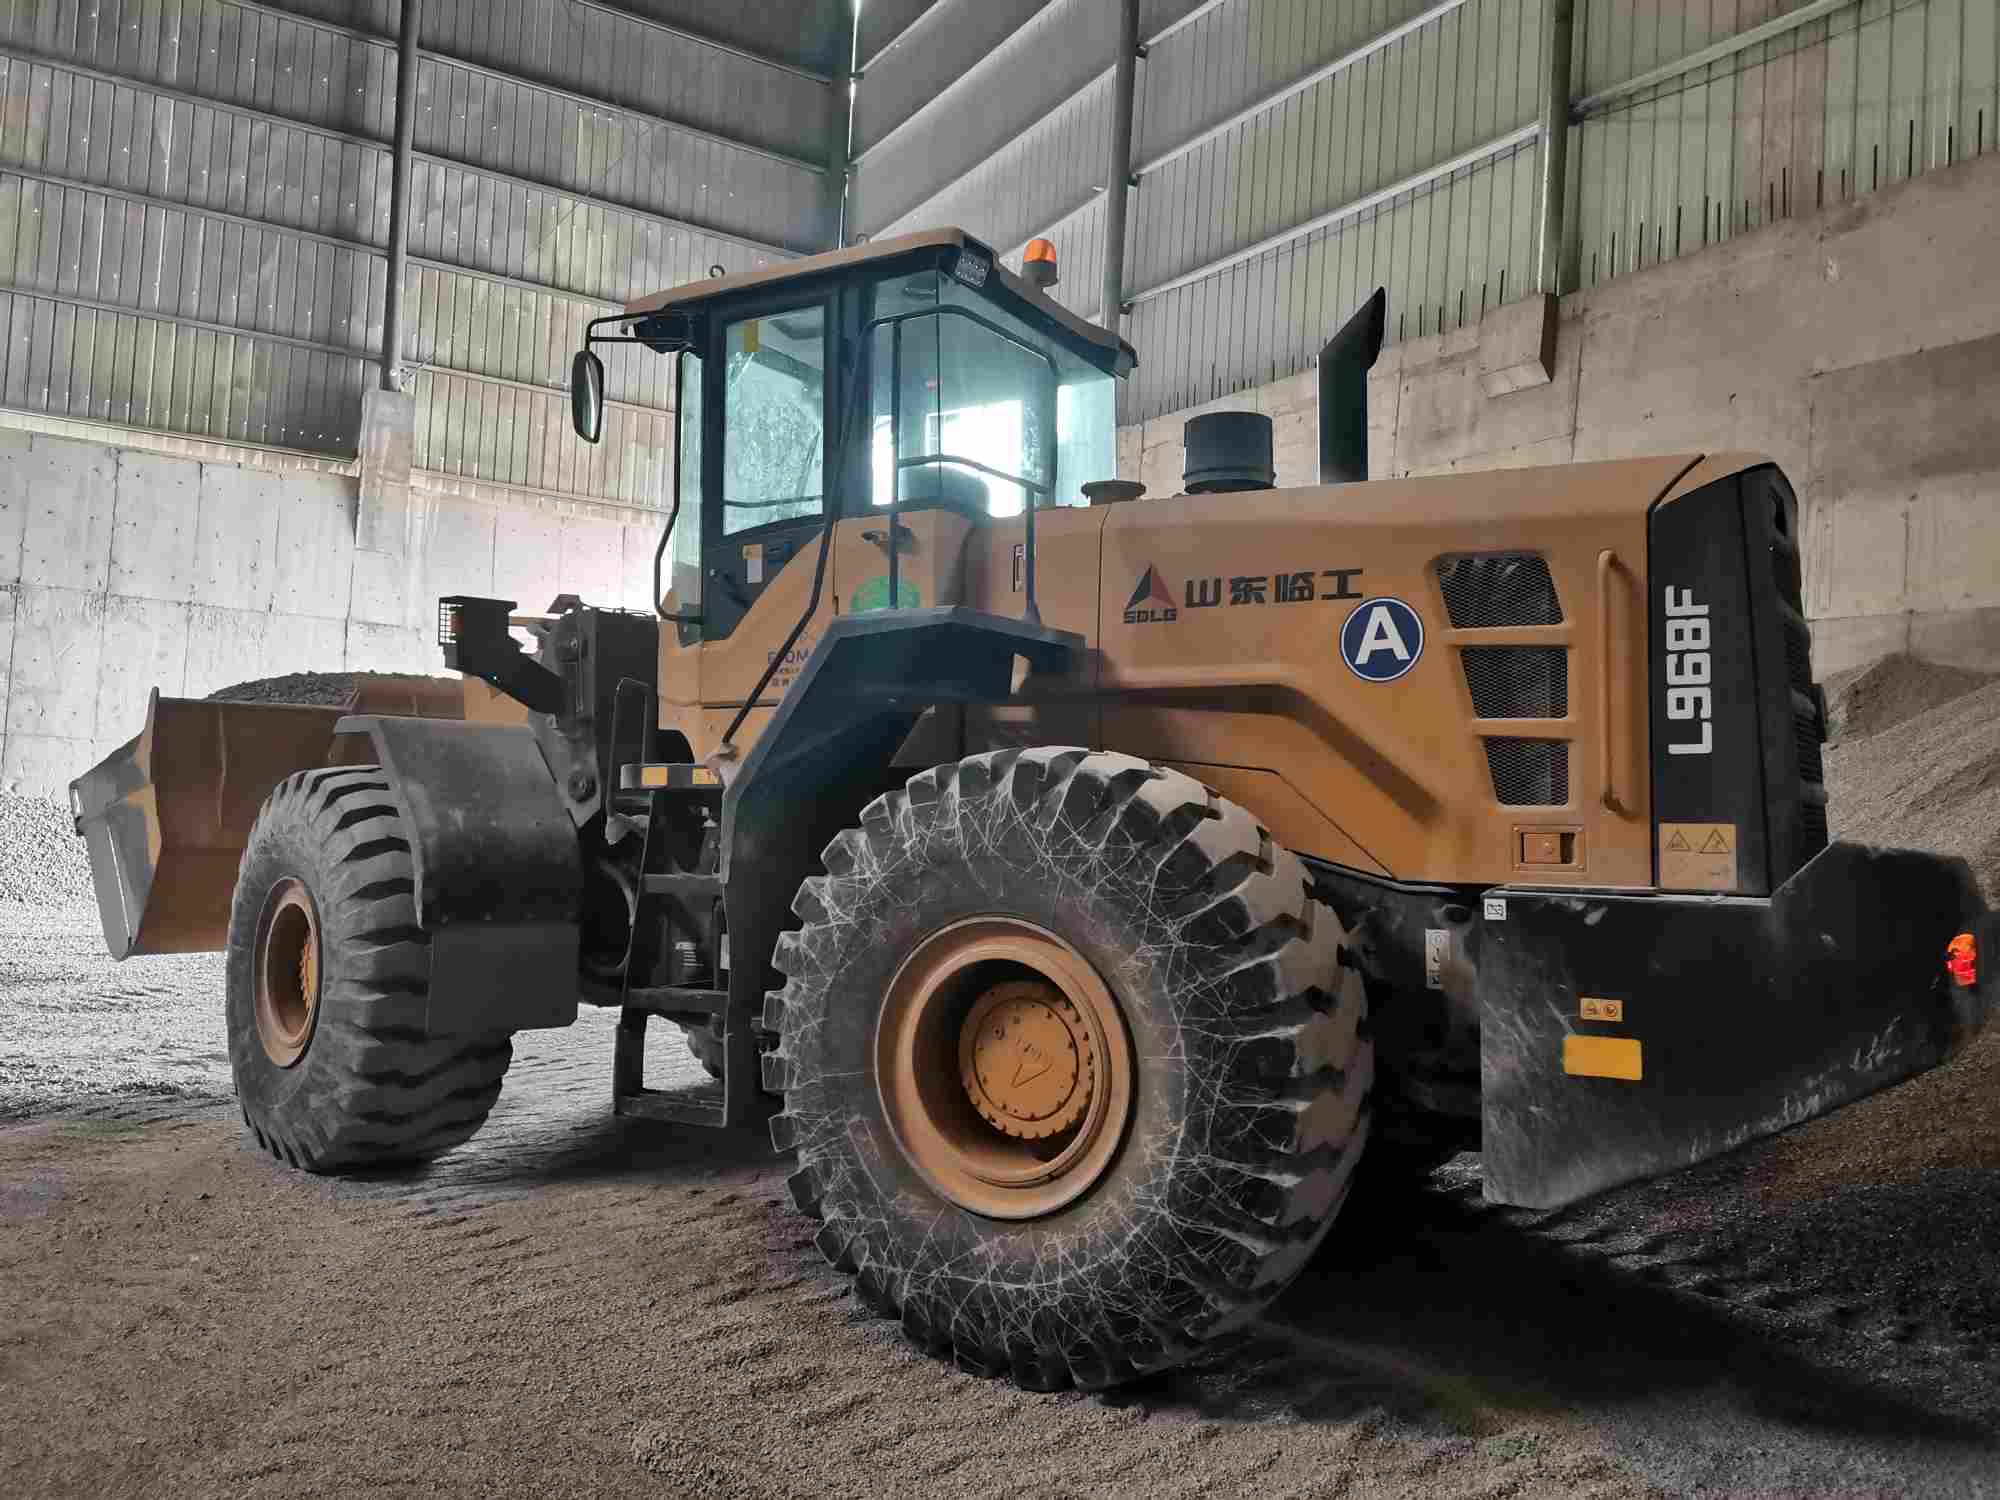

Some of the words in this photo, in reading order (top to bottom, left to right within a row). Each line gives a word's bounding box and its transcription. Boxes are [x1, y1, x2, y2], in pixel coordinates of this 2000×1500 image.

[1185, 568, 1363, 608] 山东临工
[1123, 609, 1177, 625] SDLG
[1354, 605, 1411, 665] A
[1665, 585, 1713, 755] L968F
